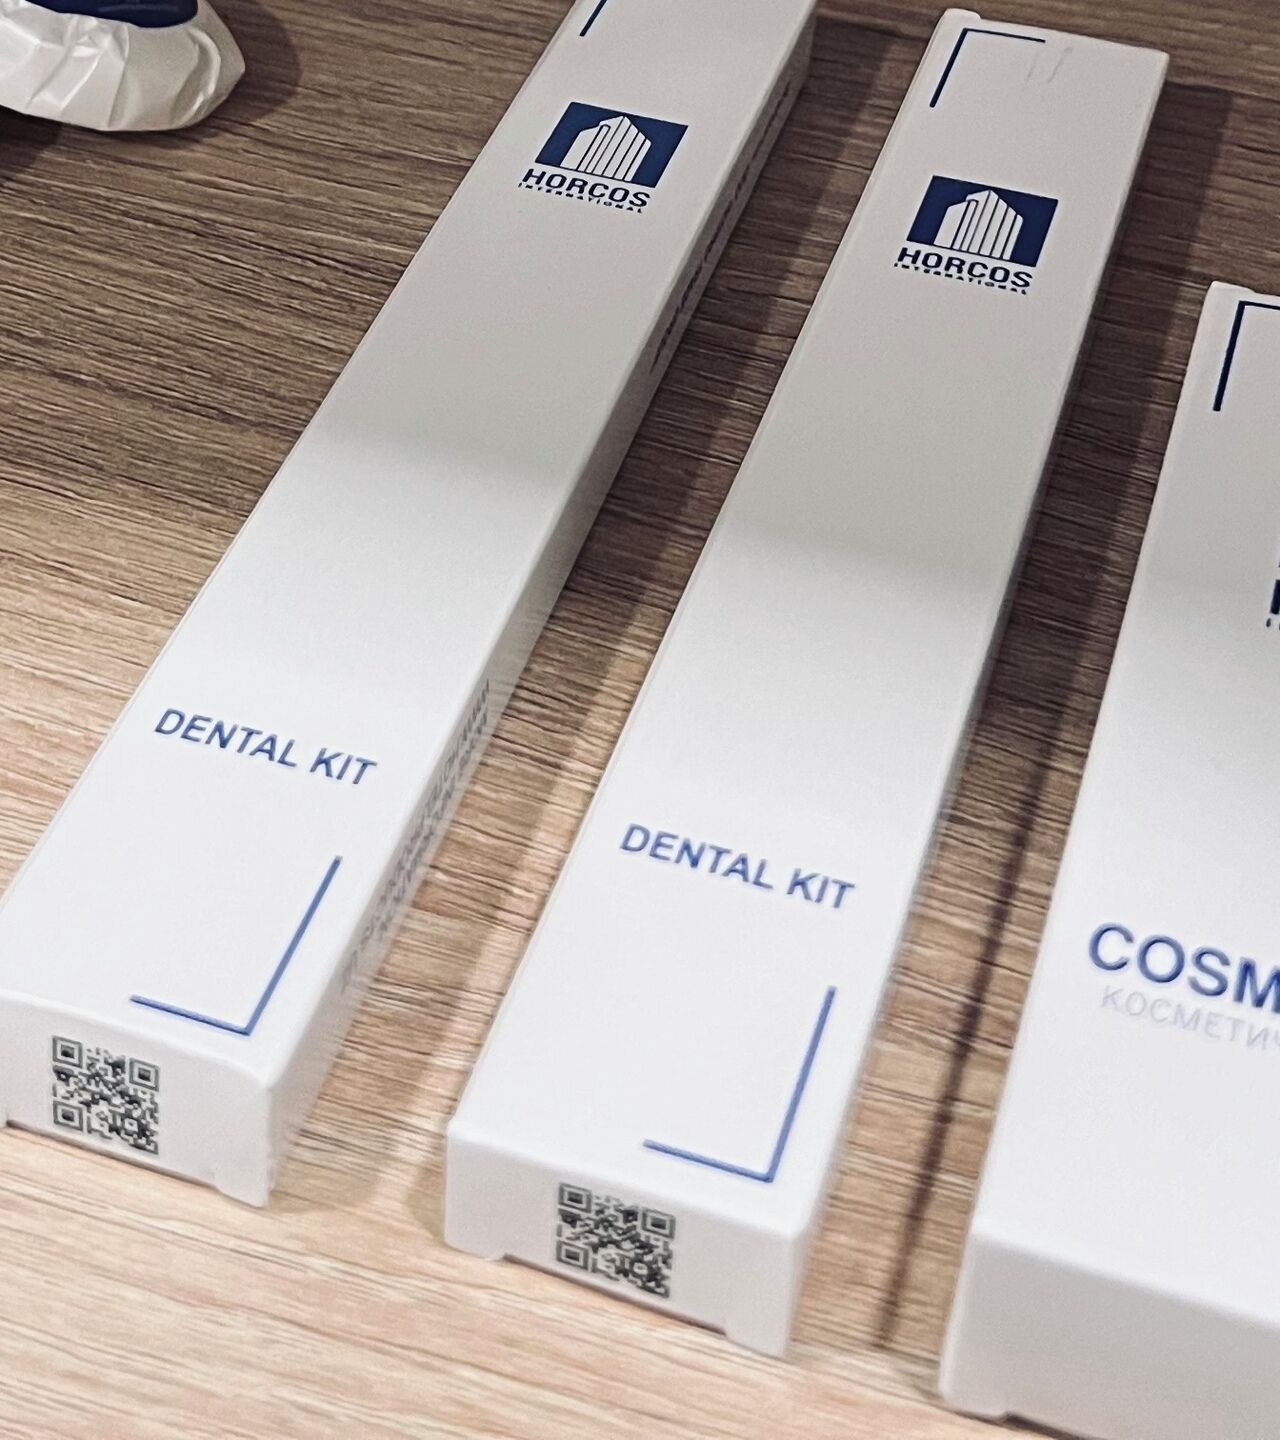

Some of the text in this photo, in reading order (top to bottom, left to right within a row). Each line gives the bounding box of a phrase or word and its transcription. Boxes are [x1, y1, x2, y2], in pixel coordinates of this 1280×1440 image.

[522, 168, 651, 207] HORCOS
[897, 247, 1033, 288] HORCOS
[154, 708, 378, 784] DENTAL KIT
[620, 823, 856, 908] DENTAL KIT
